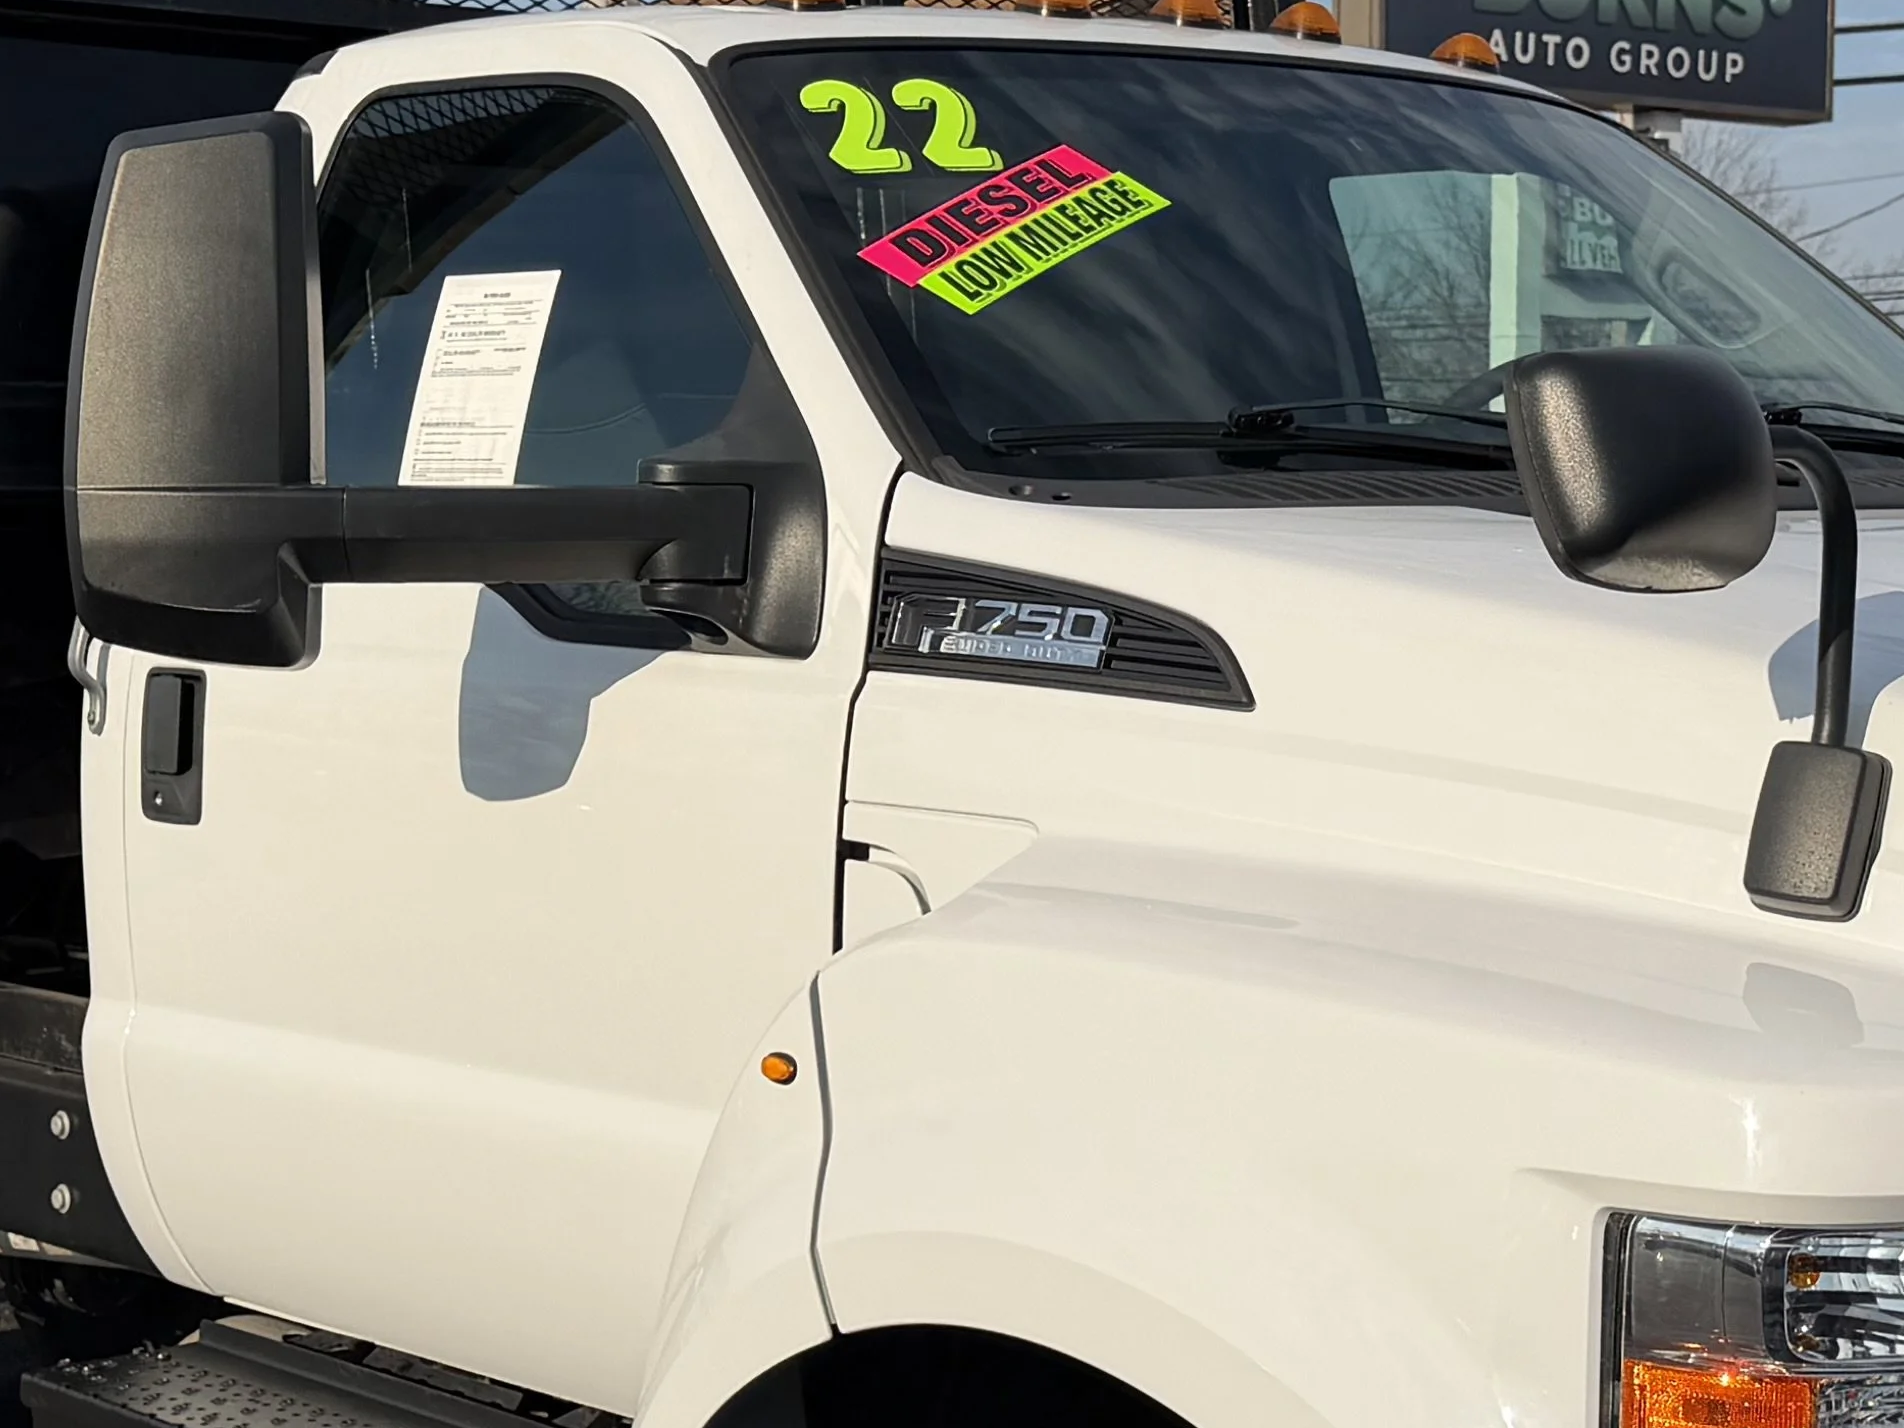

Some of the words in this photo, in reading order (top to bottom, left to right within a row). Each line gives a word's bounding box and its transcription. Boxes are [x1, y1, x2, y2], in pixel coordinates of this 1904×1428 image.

[1489, 27, 1590, 70] AUTO
[1609, 40, 1745, 84] GROUP
[799, 78, 1004, 174] 22
[888, 157, 1093, 268] DIESEL
[938, 238, 1032, 305] LOW
[1017, 178, 1149, 266] MILEAGE
